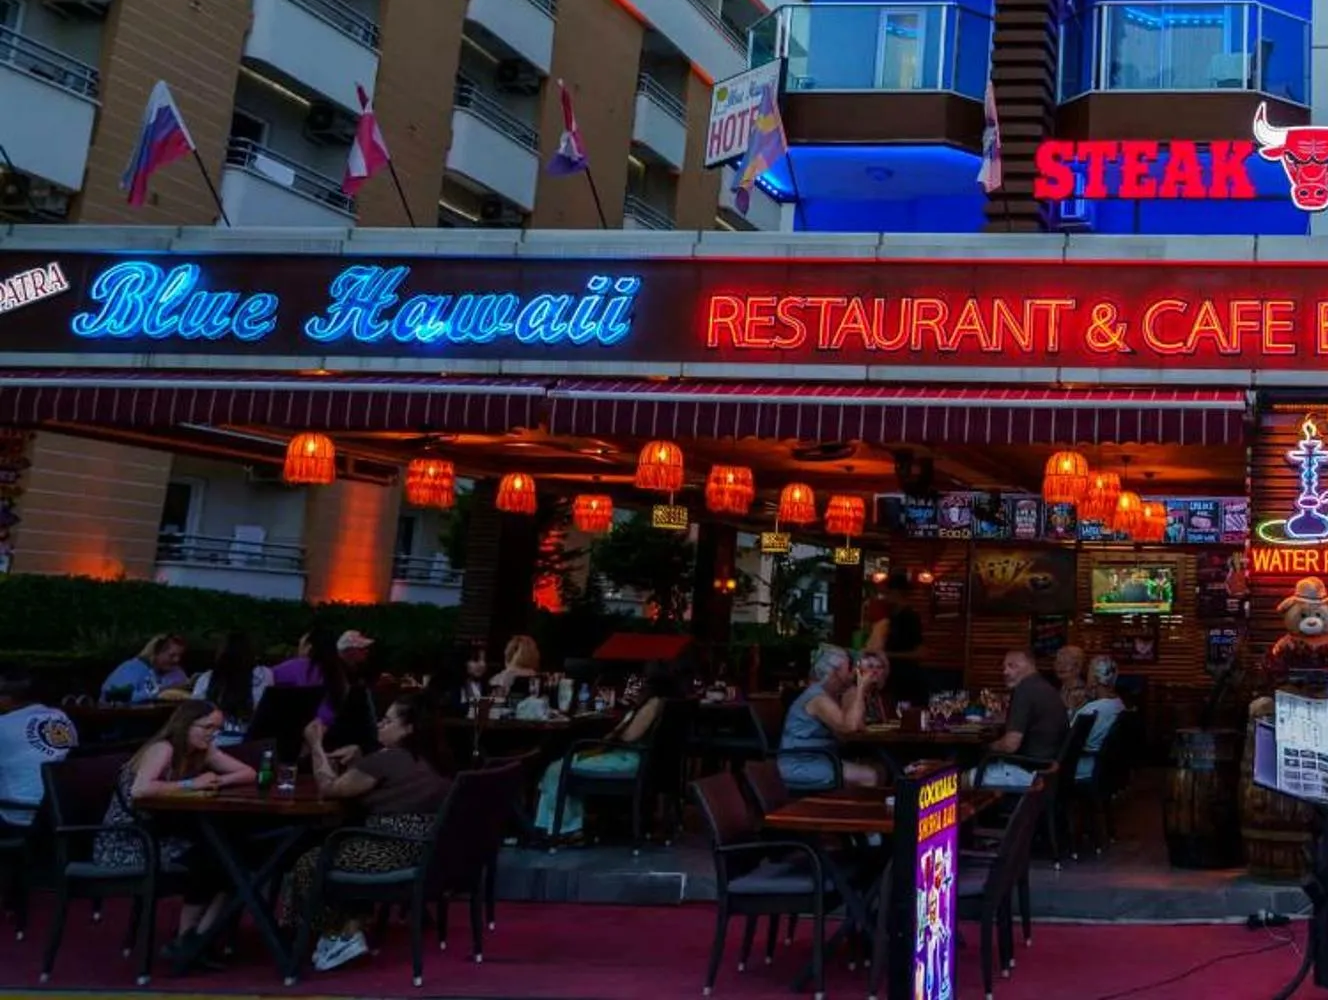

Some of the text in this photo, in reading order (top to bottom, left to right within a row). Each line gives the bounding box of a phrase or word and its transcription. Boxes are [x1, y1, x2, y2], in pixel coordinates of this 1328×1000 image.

[708, 104, 760, 158] HOTE
[1035, 140, 1256, 200] STEAK
[72, 260, 641, 344] Blue Hawaii
[706, 294, 1074, 353] RESTAURANT
[1087, 299, 1130, 353] &
[1142, 298, 1296, 355] CAFE
[1253, 549, 1319, 573] WATER
